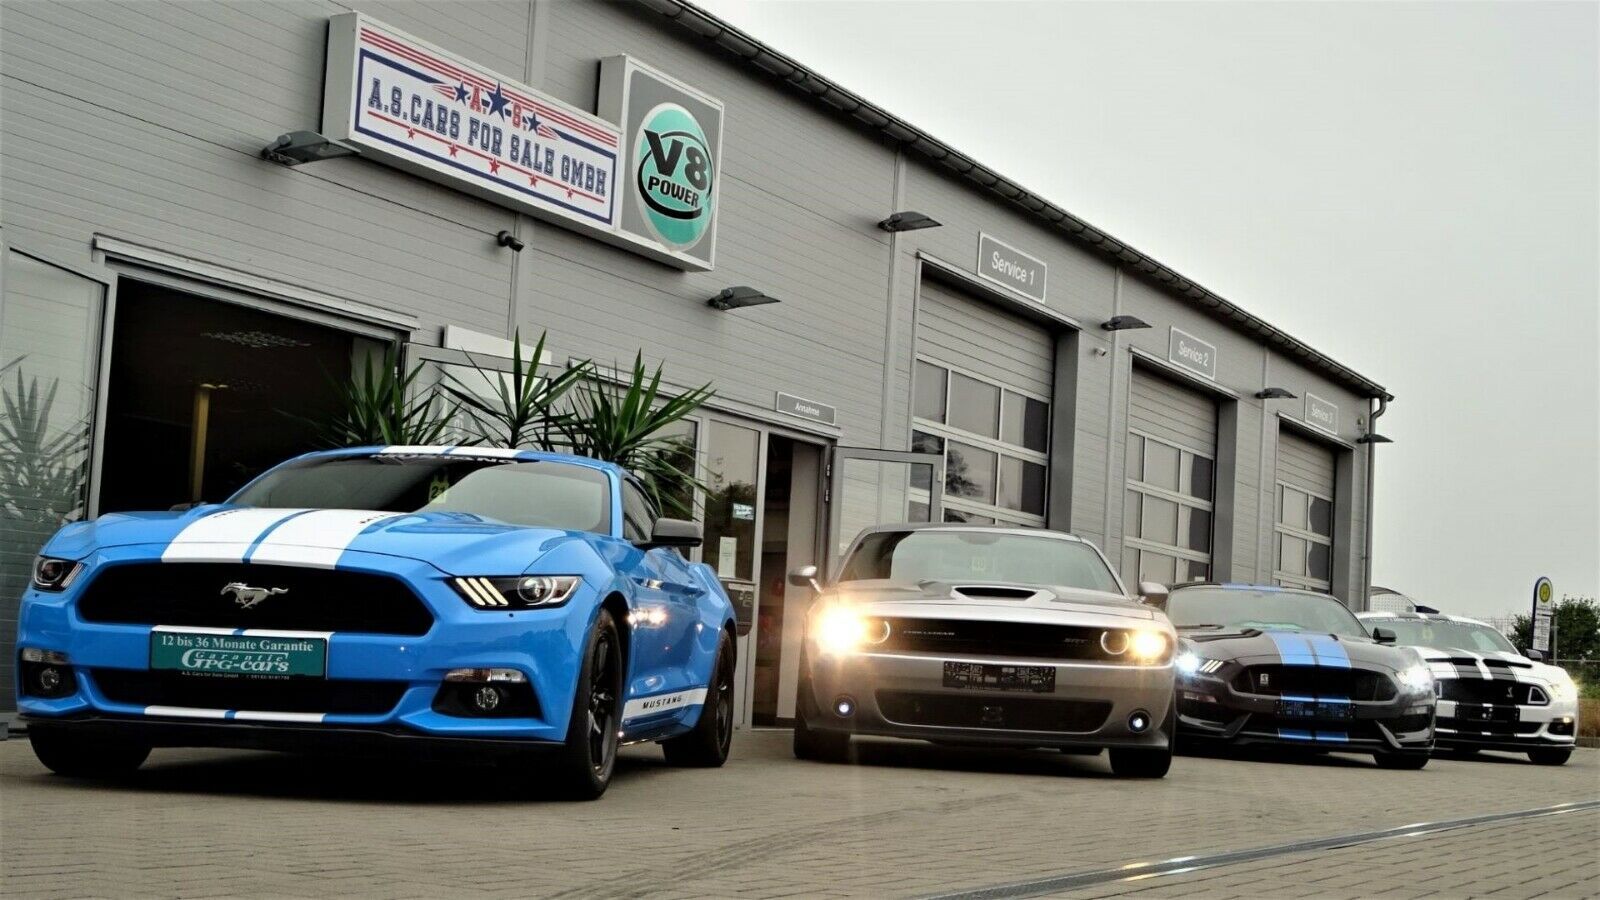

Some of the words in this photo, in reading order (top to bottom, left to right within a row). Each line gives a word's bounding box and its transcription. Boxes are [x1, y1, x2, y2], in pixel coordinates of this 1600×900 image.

[467, 116, 503, 158] FOR
[510, 133, 555, 177] SALE
[560, 154, 607, 197] GMBH
[643, 129, 708, 191] V8
[647, 175, 700, 208] POWER
[991, 251, 1027, 282] Service
[1178, 340, 1202, 364] Service
[794, 401, 820, 417] Annahme
[161, 635, 174, 646] 12
[177, 636, 193, 648] bis
[195, 637, 209, 648] 36
[212, 638, 257, 650] Monate
[260, 640, 314, 652] Garantie
[642, 695, 682, 709] MUSTANG
